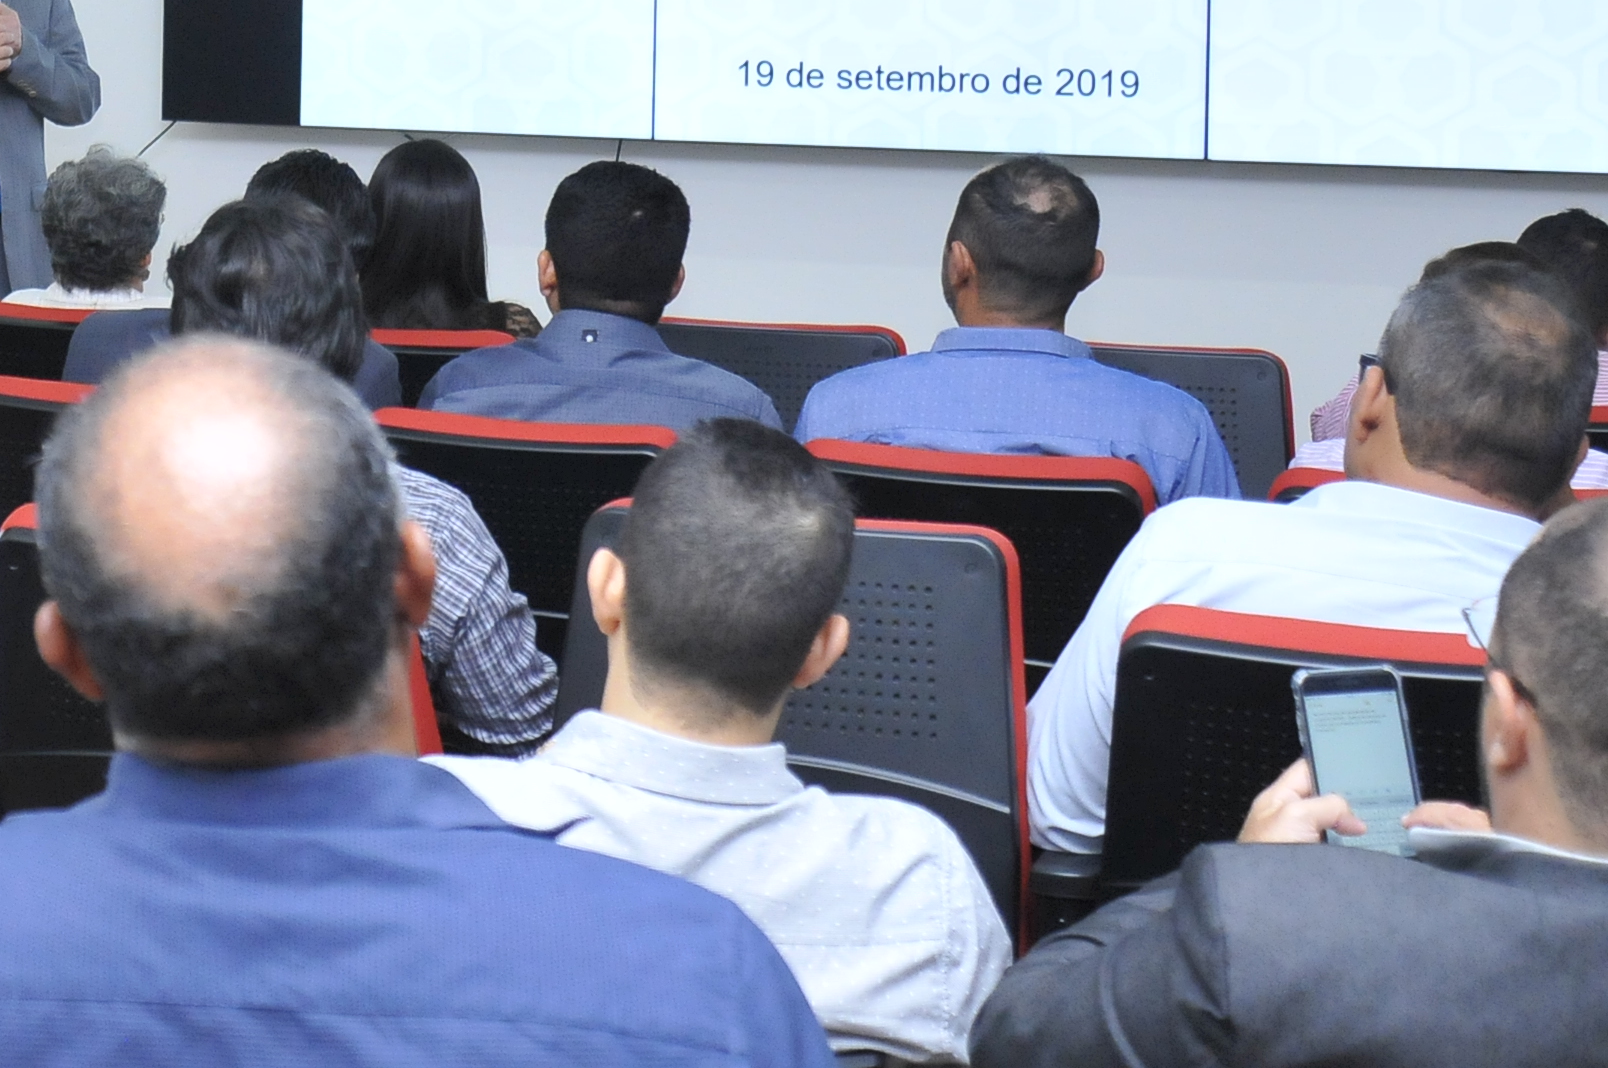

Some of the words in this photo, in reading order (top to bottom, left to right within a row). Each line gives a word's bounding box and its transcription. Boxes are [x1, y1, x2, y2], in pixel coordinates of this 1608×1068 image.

[738, 59, 774, 87] 19
[786, 61, 825, 89] de
[836, 64, 991, 94] setembro
[1002, 67, 1042, 95] de
[1055, 68, 1140, 98] 2019
